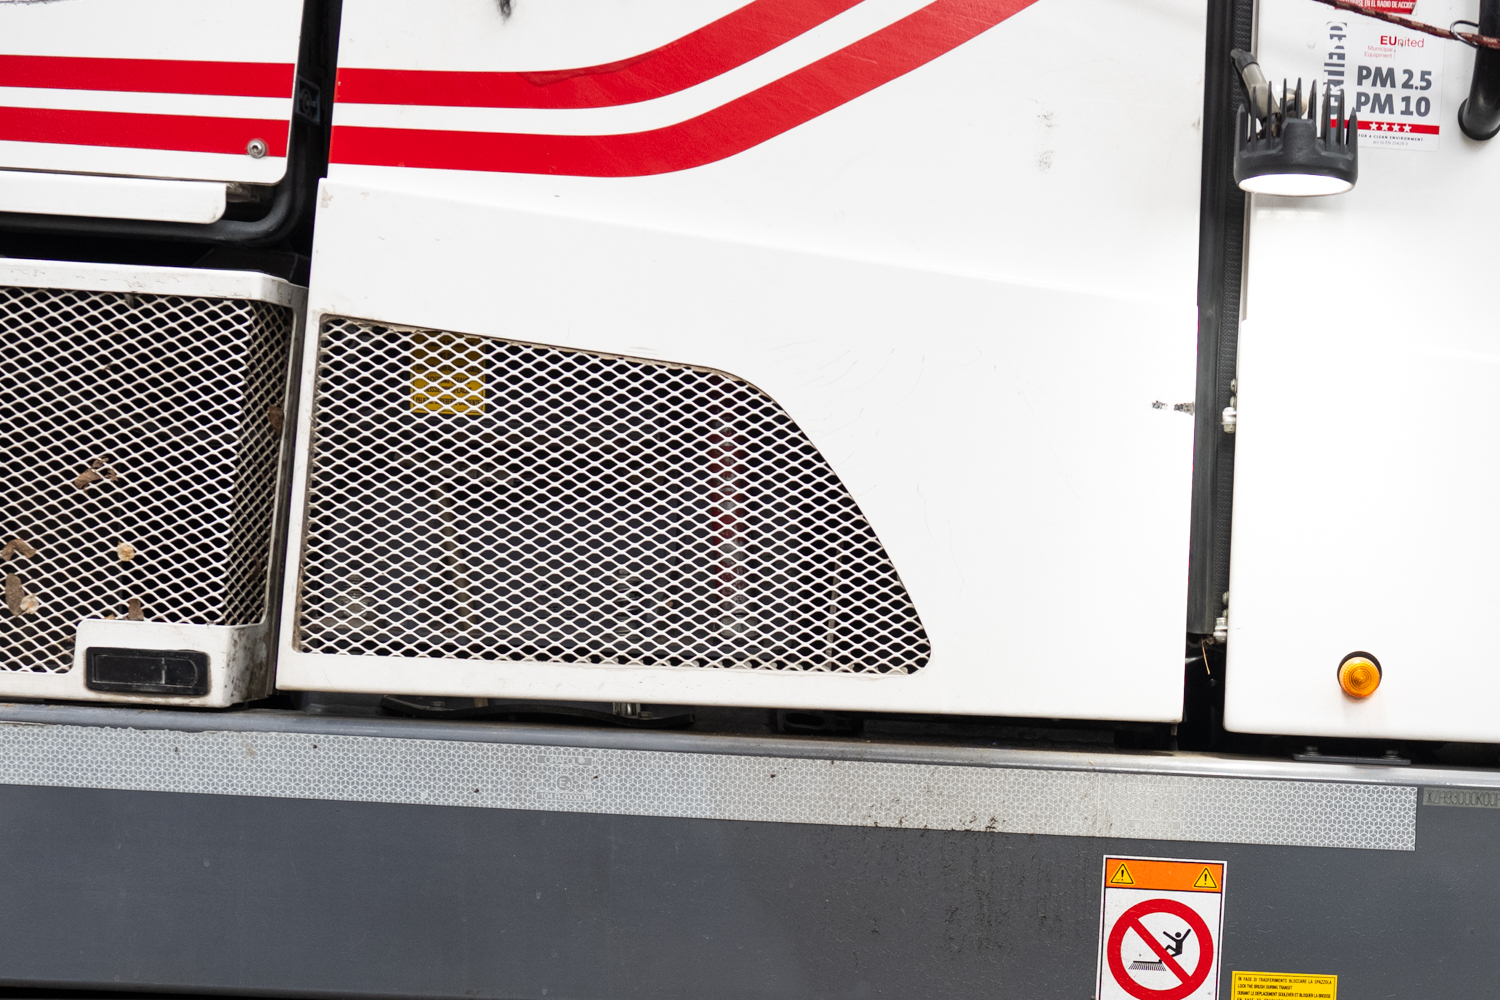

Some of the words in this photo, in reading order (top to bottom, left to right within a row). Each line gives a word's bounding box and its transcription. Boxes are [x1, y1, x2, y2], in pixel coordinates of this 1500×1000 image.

[1380, 36, 1425, 48] EUnited
[1357, 65, 1396, 88] PM
[1401, 69, 1432, 91] 2.5
[1355, 91, 1394, 115] PM
[1400, 95, 1431, 117] 10
